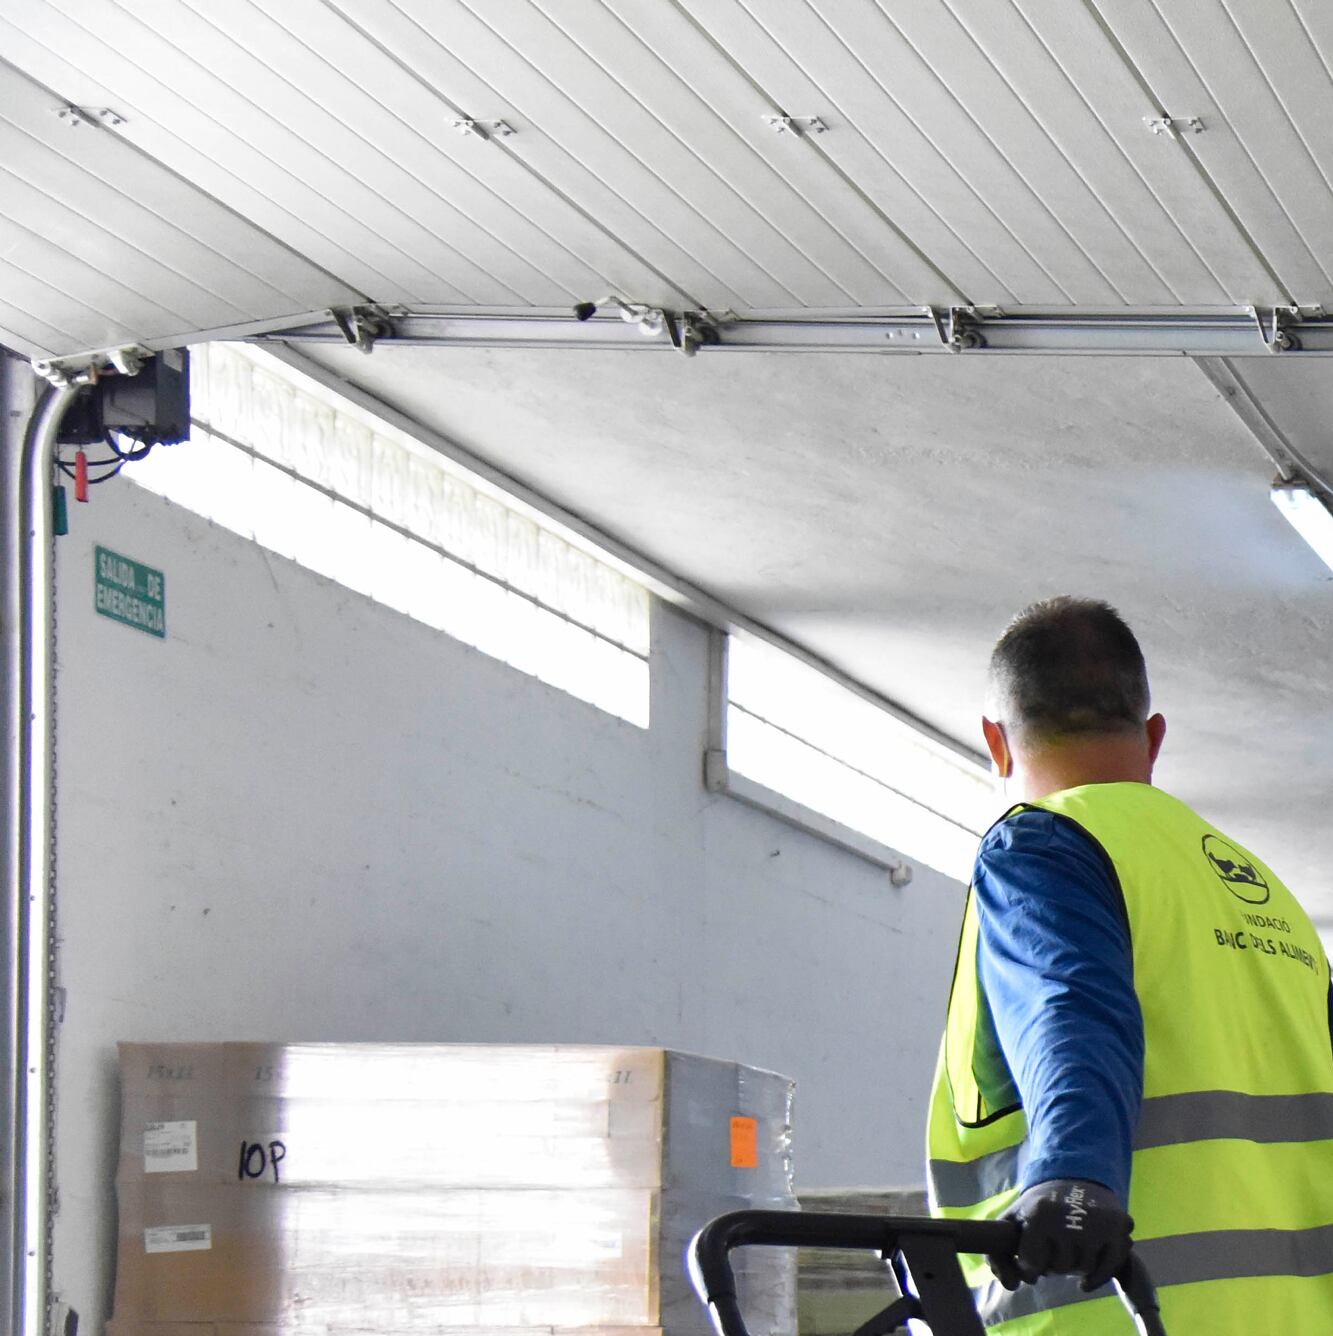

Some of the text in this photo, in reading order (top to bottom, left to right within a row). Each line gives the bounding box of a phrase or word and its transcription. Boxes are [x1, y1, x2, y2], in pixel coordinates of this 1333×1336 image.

[100, 552, 161, 601] SALIDA DE
[97, 582, 164, 632] EMERGENCIA
